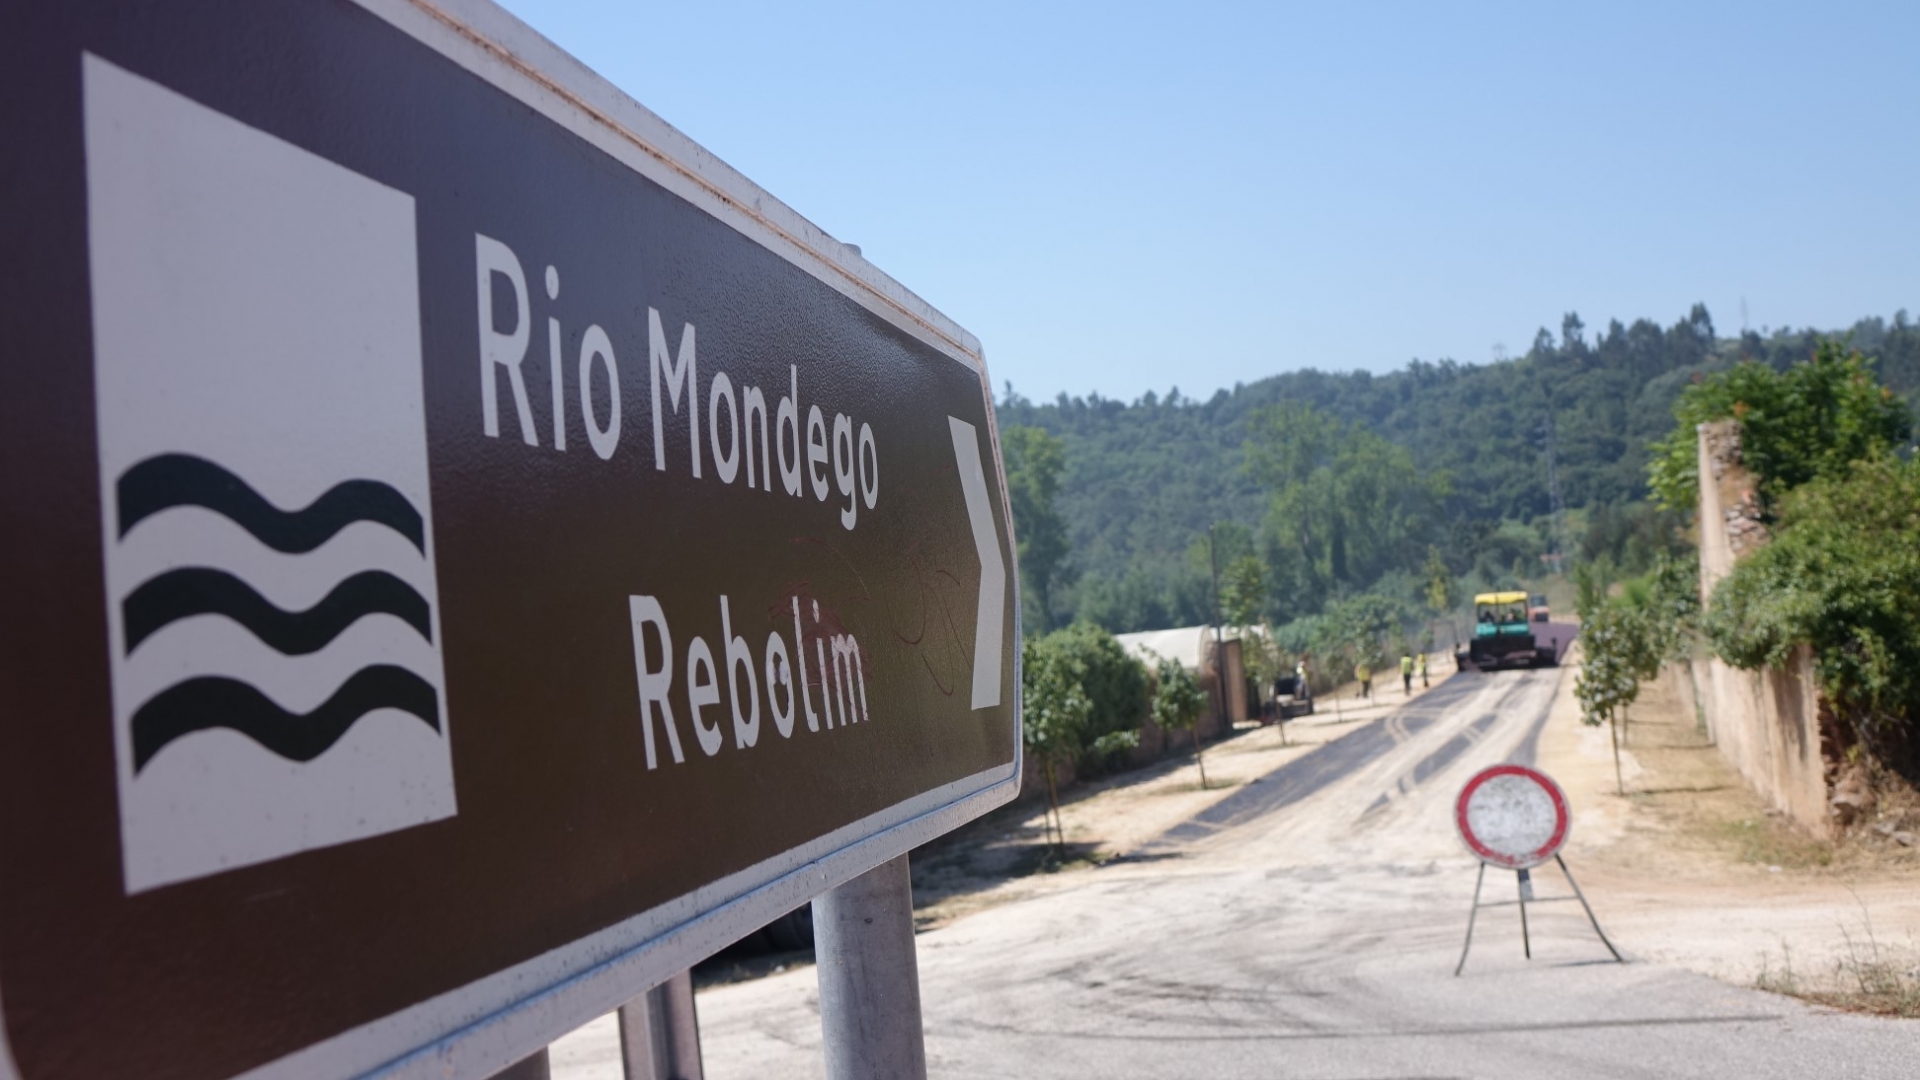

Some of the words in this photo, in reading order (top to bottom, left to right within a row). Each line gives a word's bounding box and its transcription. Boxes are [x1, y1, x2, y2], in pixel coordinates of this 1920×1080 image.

[475, 233, 622, 460] Rio
[648, 306, 879, 531] Mondego
[629, 594, 869, 770] Rebolim
